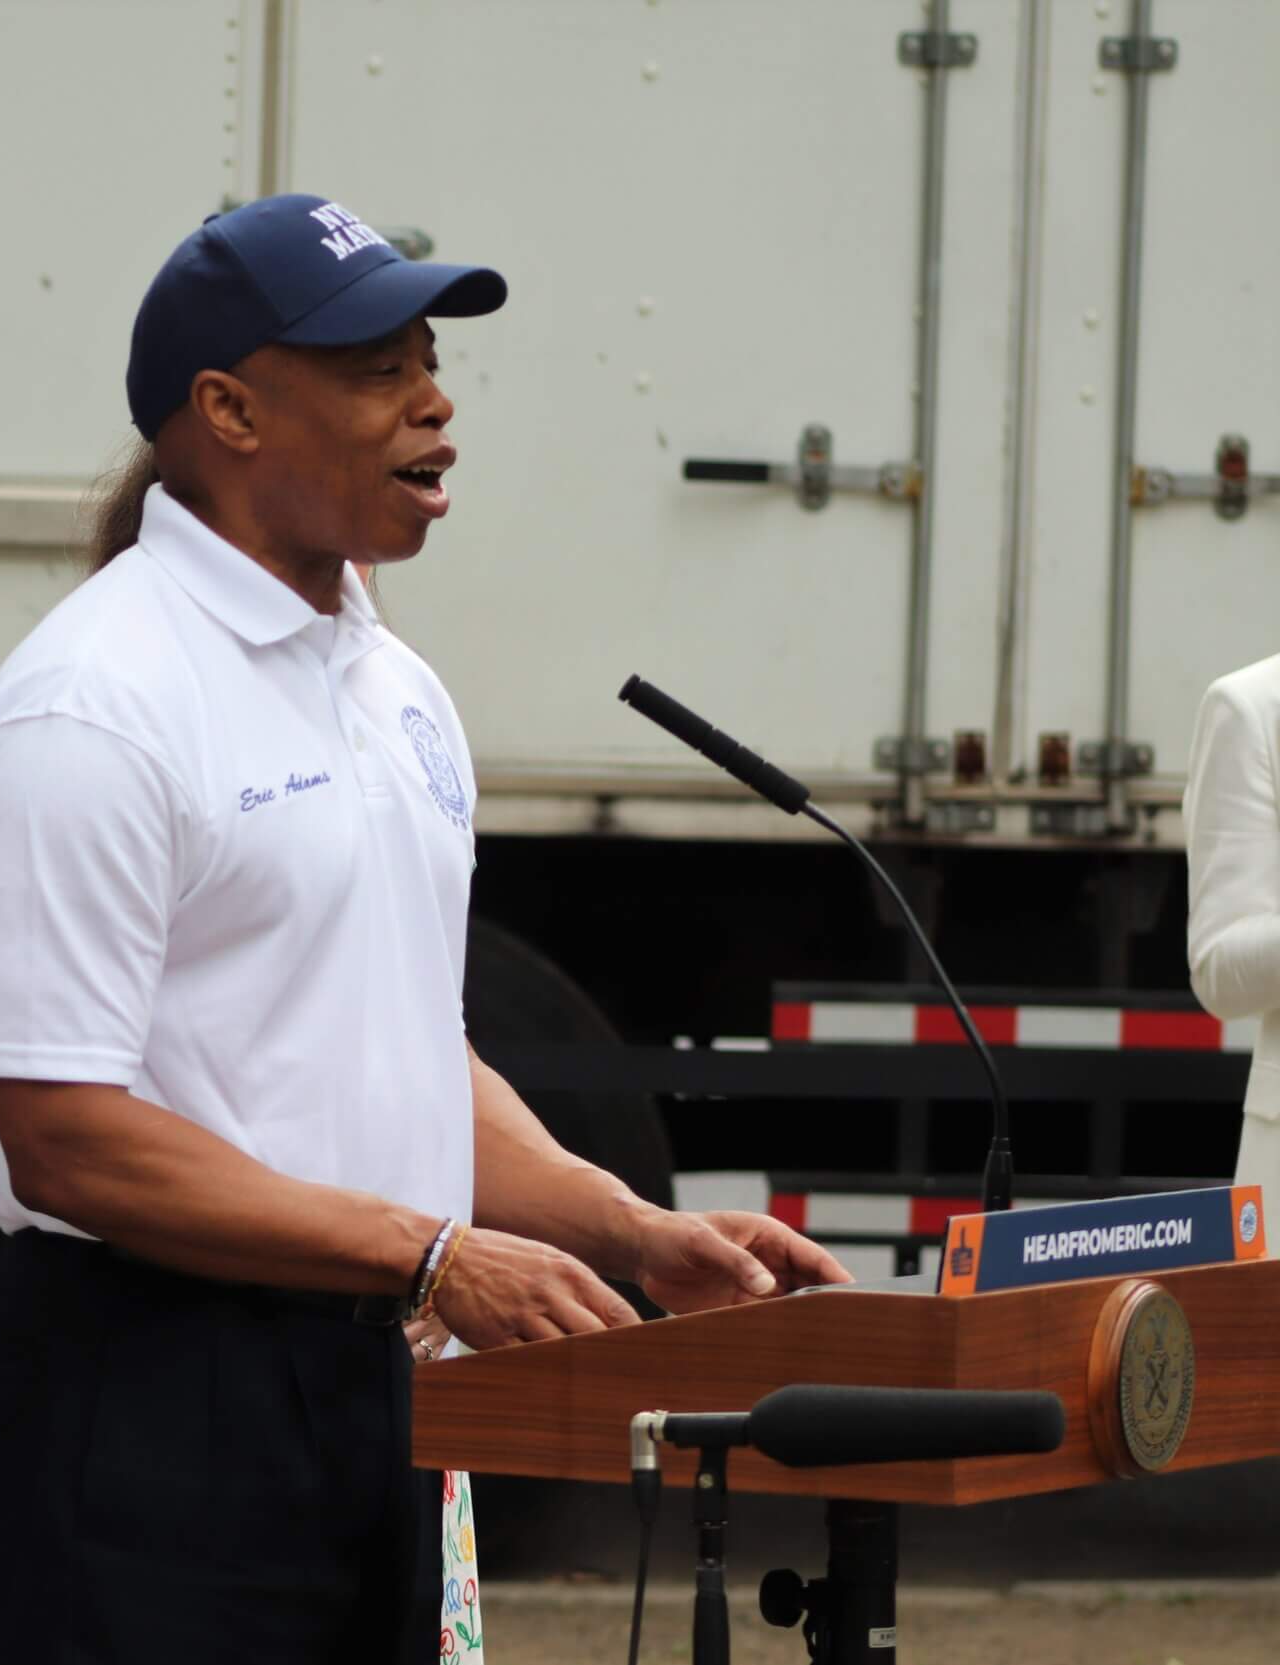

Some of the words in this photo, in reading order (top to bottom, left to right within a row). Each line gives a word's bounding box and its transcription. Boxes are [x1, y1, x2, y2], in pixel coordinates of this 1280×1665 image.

[240, 787, 276, 812] Eric
[284, 771, 331, 796] Adams
[1022, 1217, 1193, 1264] HEARFROMERIC.COM
